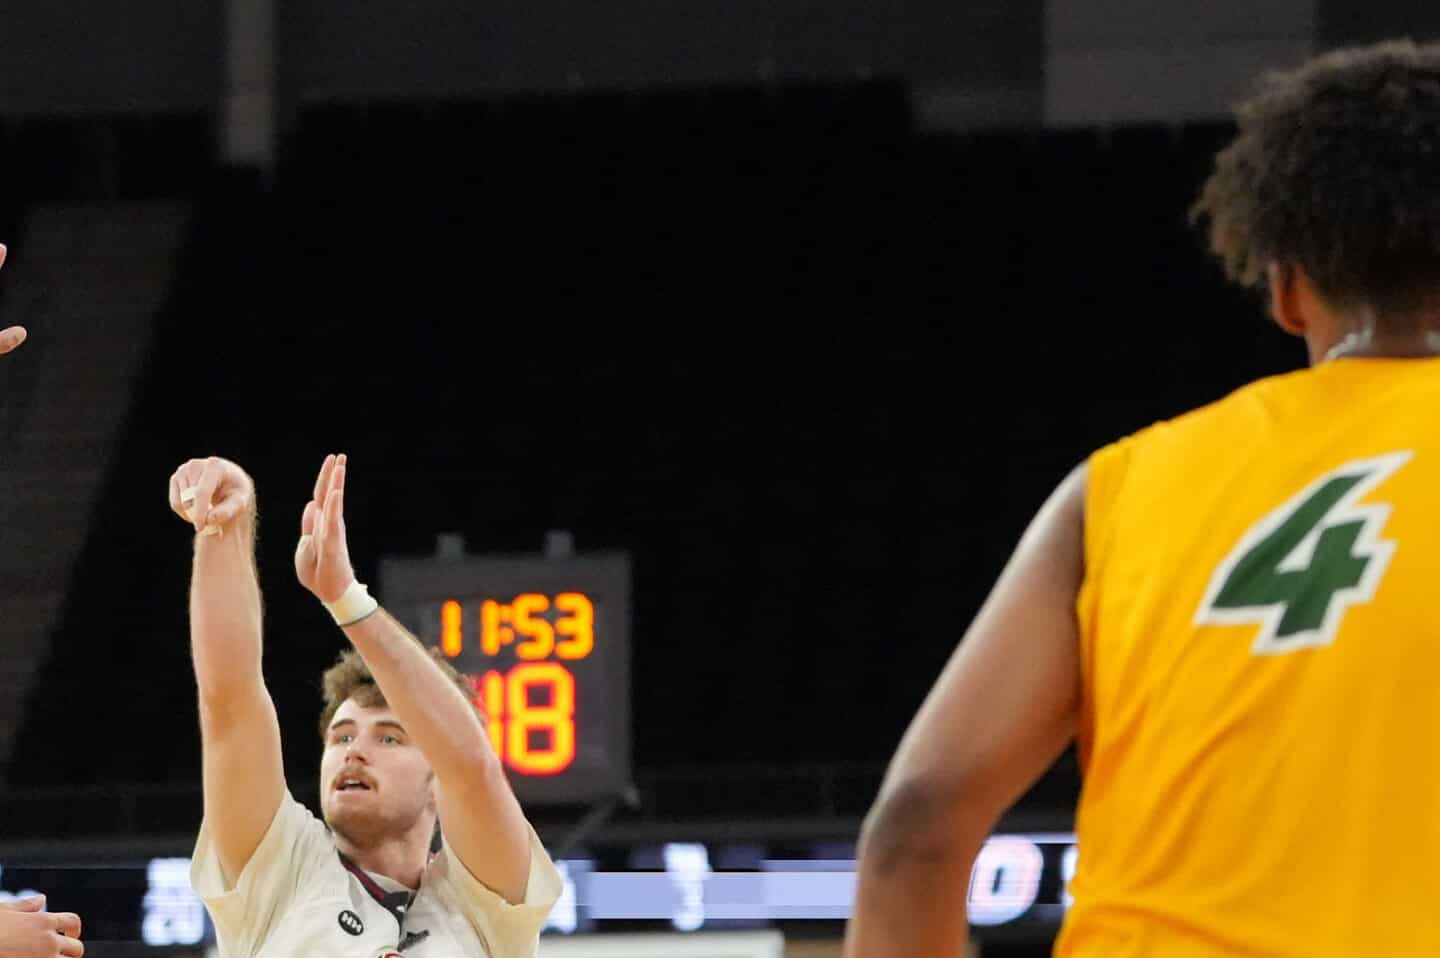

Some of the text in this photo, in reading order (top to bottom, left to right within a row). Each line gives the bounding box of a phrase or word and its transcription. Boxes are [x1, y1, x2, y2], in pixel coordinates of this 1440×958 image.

[1193, 449, 1414, 653] 4
[441, 592, 594, 660] 11:53
[481, 661, 575, 774] 18
